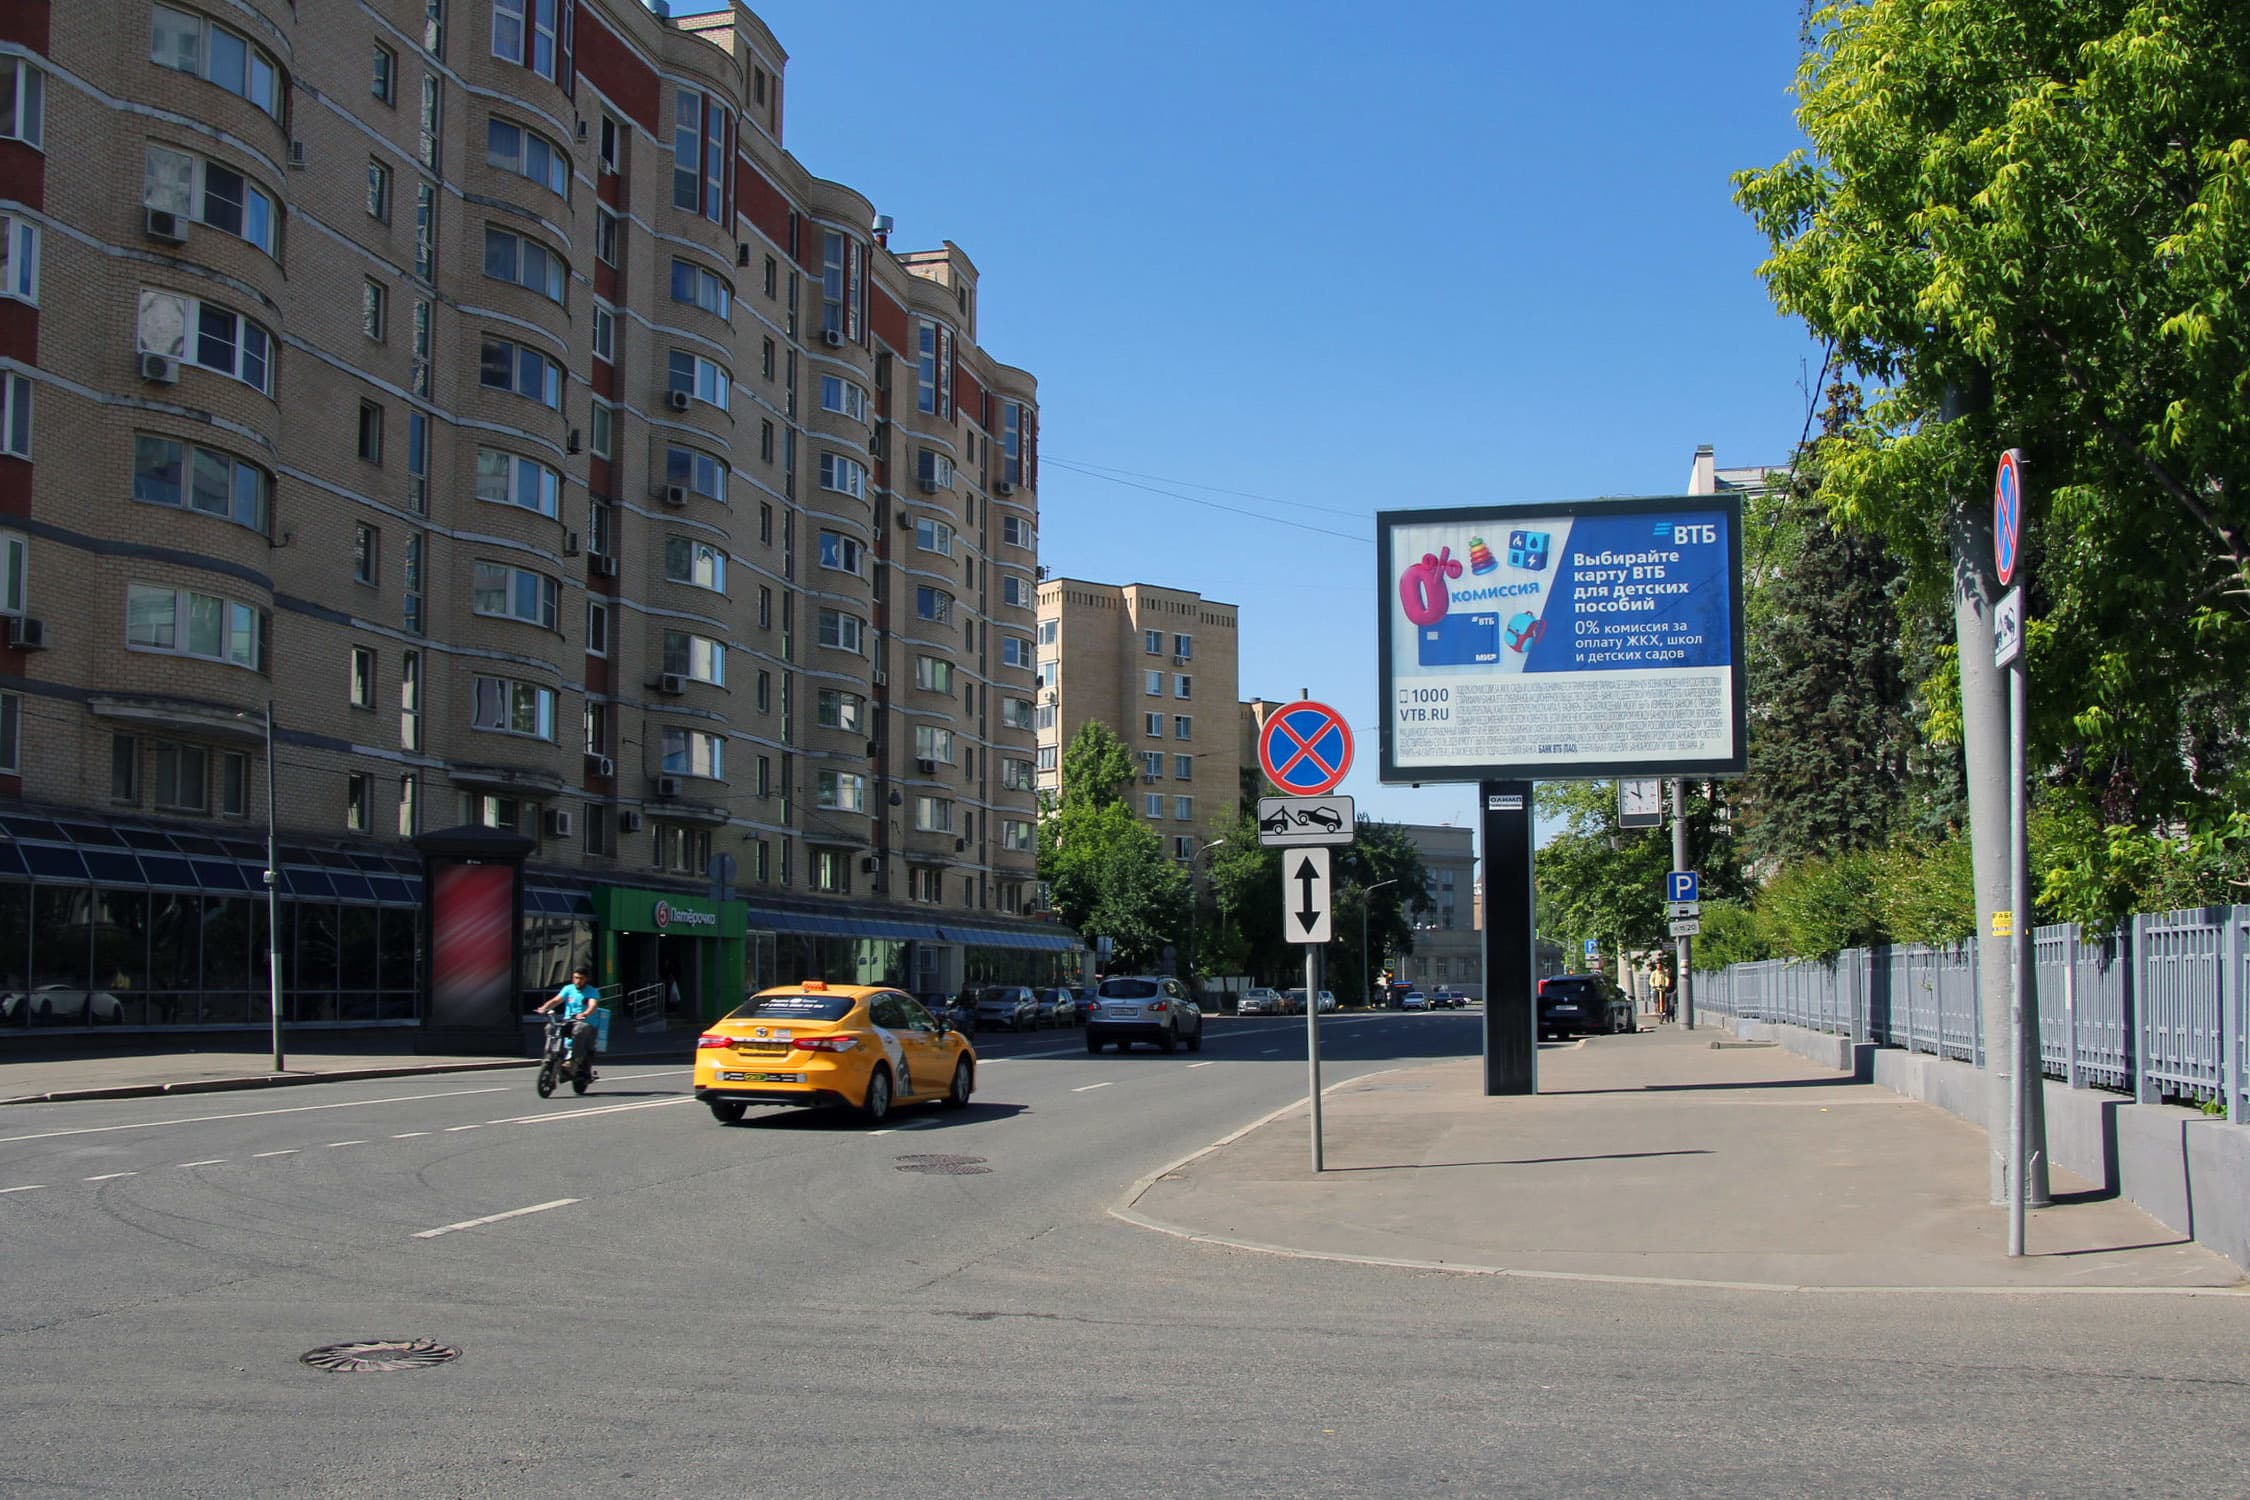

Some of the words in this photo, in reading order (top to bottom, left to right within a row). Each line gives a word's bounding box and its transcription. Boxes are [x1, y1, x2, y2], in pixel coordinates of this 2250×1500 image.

[1674, 524, 1717, 545] ВТБ
[1573, 549, 1680, 568] Выбирайте
[1574, 569, 1628, 584] карту
[1632, 565, 1666, 580] ВТБ
[1573, 586, 1608, 600] для
[1613, 583, 1689, 598] детских
[1574, 596, 1655, 613] пособий
[1575, 620, 1600, 635] 0%
[1604, 622, 1669, 634] комиссия
[1672, 622, 1688, 632] за
[1575, 637, 1623, 650] оплату
[1626, 635, 1664, 647] ЖКХ,
[1667, 634, 1703, 645] школ
[1575, 652, 1584, 662] и
[1587, 650, 1642, 663] детских
[1645, 649, 1685, 660] садов
[1411, 688, 1449, 702] 1000
[1399, 708, 1450, 721] VTB.RU
[1677, 875, 1692, 898] P
